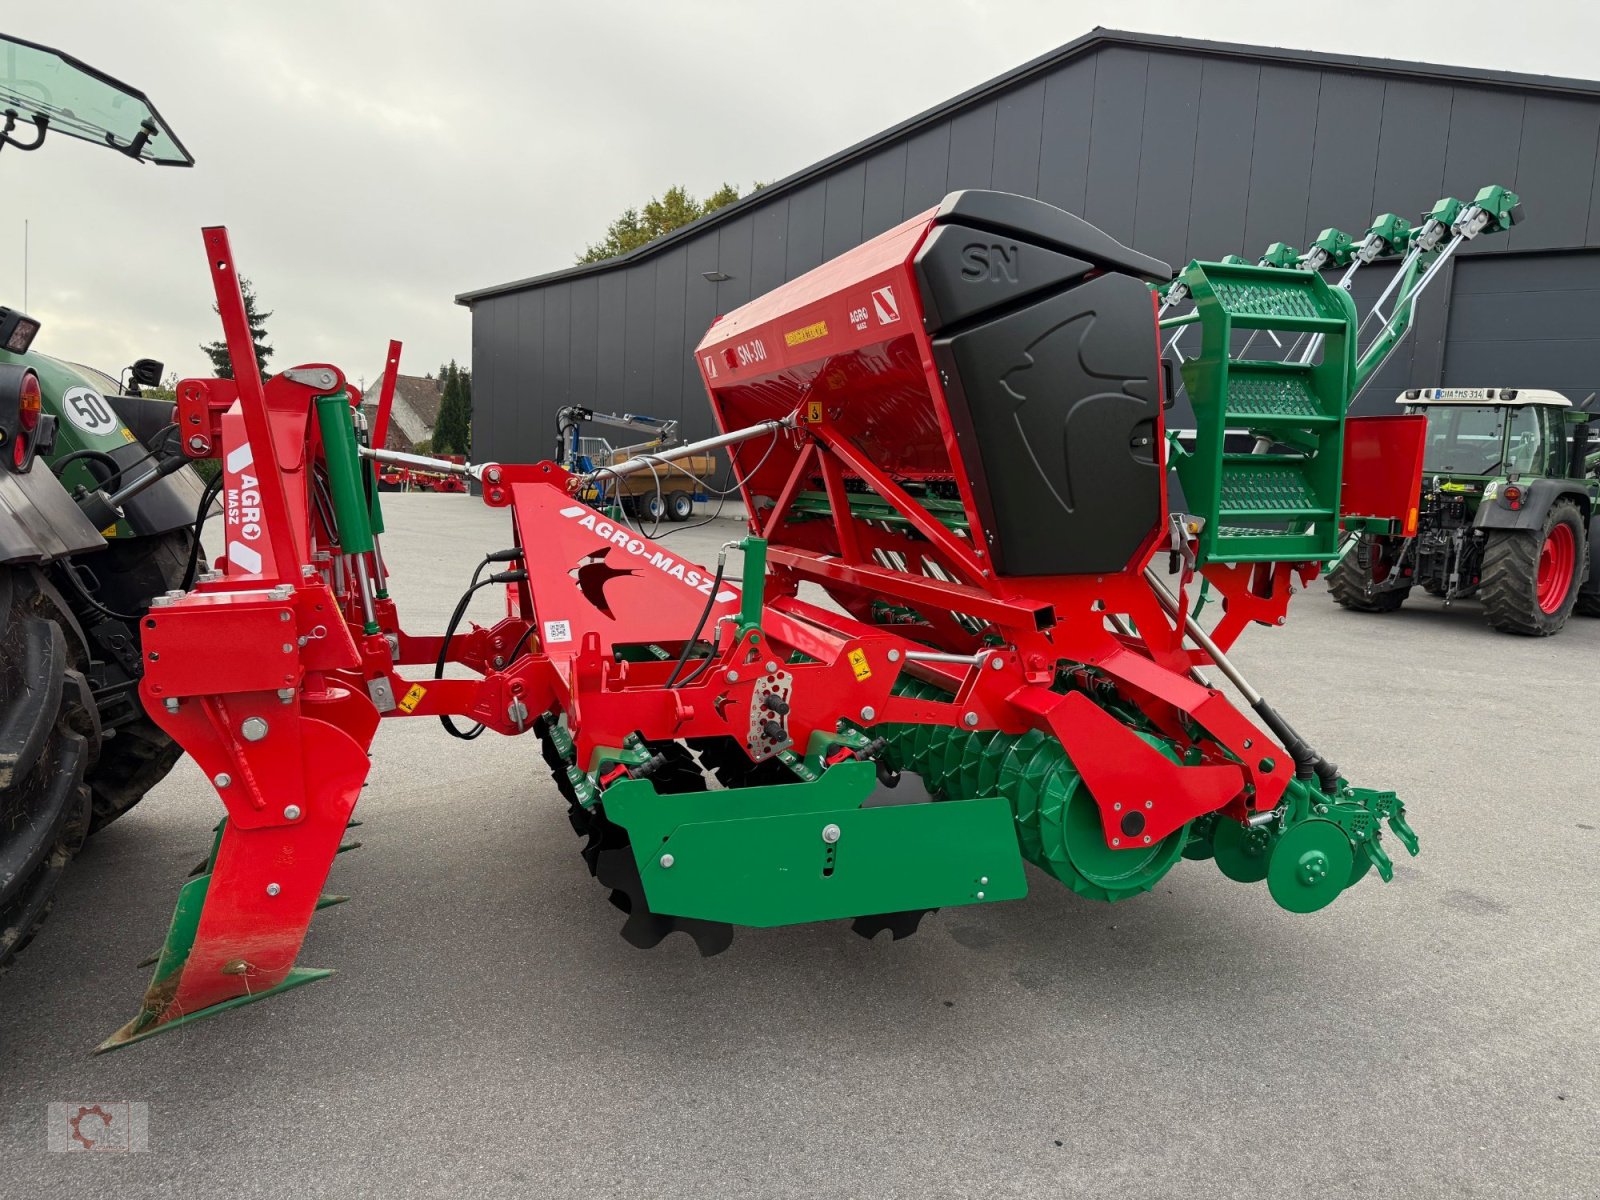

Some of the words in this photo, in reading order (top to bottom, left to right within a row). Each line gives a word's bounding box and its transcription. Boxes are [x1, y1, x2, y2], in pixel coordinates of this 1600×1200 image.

[961, 243, 1018, 282] SN
[849, 307, 868, 324] AGRO
[69, 393, 111, 428] 50
[228, 489, 239, 525] MASZ
[241, 473, 261, 540] AGRO
[578, 515, 717, 597] AGRO-MASZ
